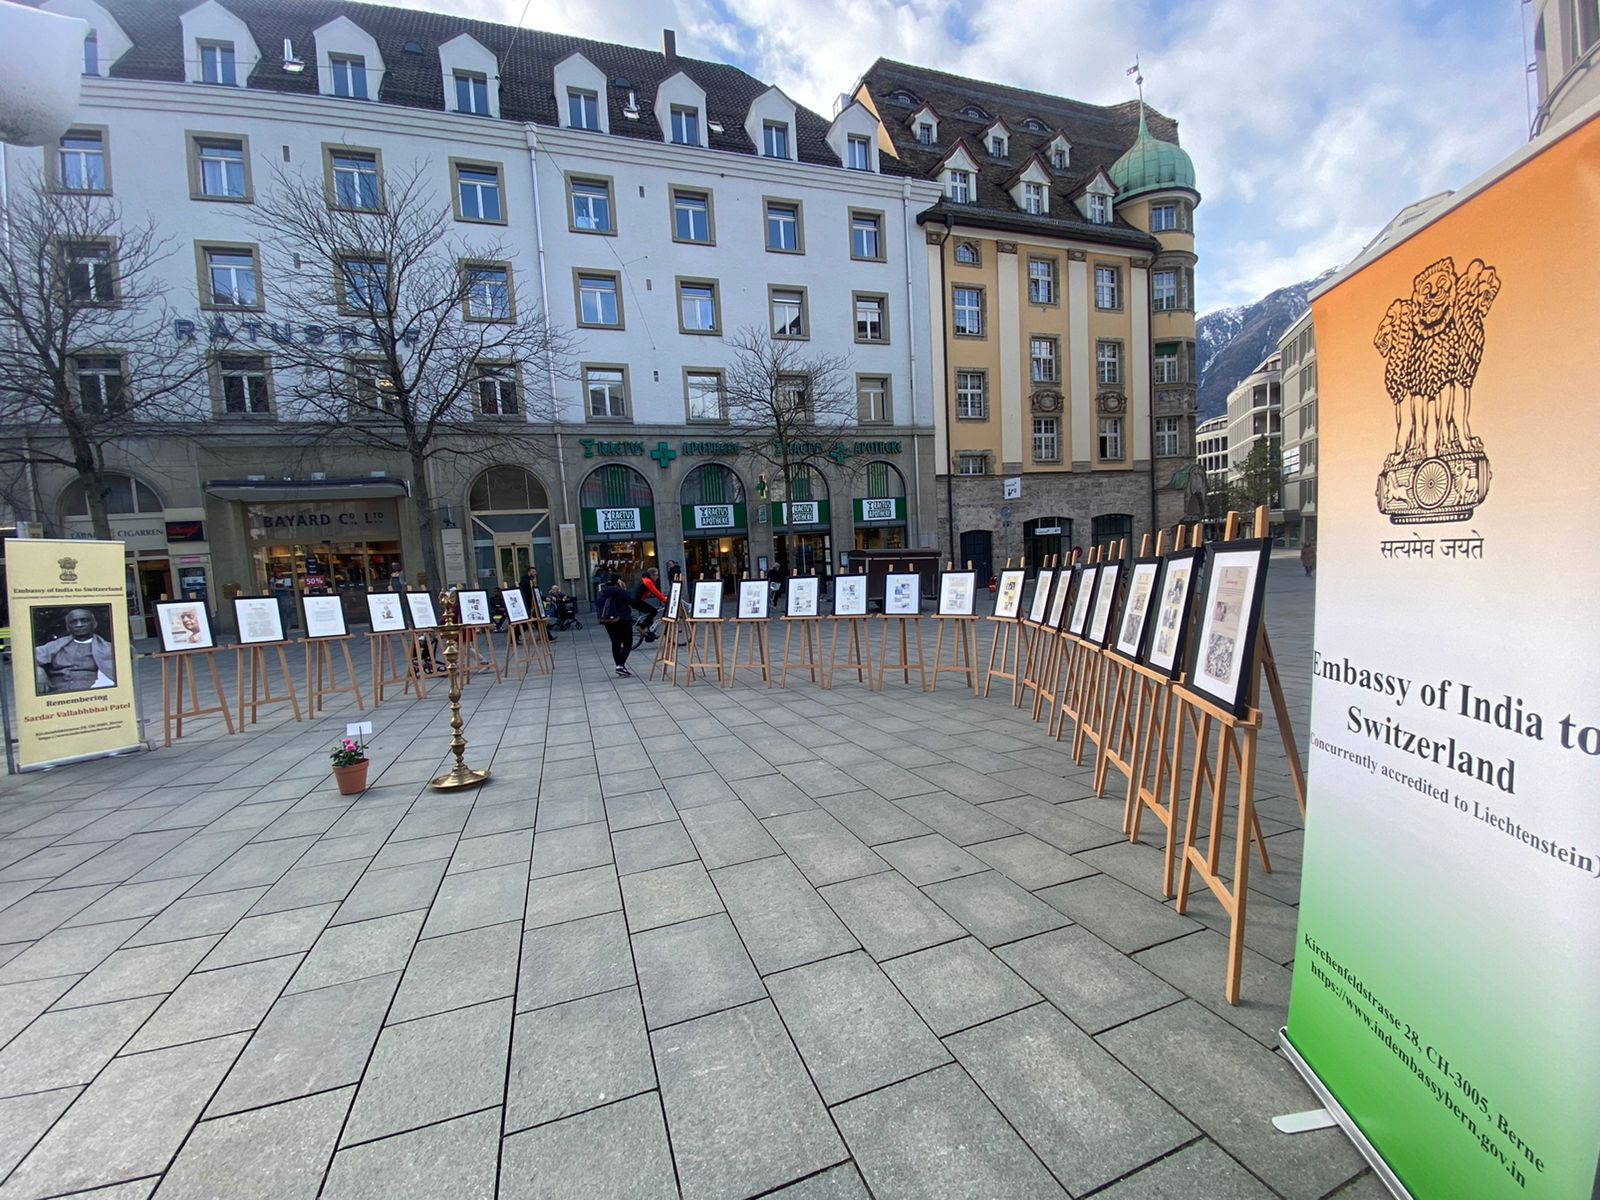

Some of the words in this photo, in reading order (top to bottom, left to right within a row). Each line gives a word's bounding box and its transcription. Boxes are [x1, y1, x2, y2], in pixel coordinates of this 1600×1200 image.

[263, 513, 331, 528] BAYARD
[792, 513, 814, 521] POTHEKE
[868, 509, 892, 518] APOTHEKE
[604, 520, 636, 530] APOTHEKE
[702, 517, 729, 526] APOTHEKE
[117, 528, 164, 538] CIGARREN
[1380, 532, 1435, 559] सत्यमेव
[1440, 529, 1484, 559] जयते
[306, 577, 324, 585] 50%
[46, 694, 108, 707] Remembering
[1312, 650, 1411, 706] Embassy
[1420, 680, 1452, 711] of
[1458, 683, 1544, 741] India
[1558, 714, 1600, 756] to
[24, 713, 55, 723] Sardar
[110, 702, 131, 711] Patel
[1347, 705, 1516, 795] Switzerland
[1381, 765, 1449, 804] accredited
[1454, 794, 1468, 813] to
[1304, 933, 1401, 1030] Kirchenfeldstrasse
[1404, 1024, 1422, 1053] 28,
[1426, 1045, 1492, 1122] CH-3005,
[1497, 1112, 1545, 1173] Berne
[1311, 961, 1526, 1189] https://www.indembassybern.gov.in
